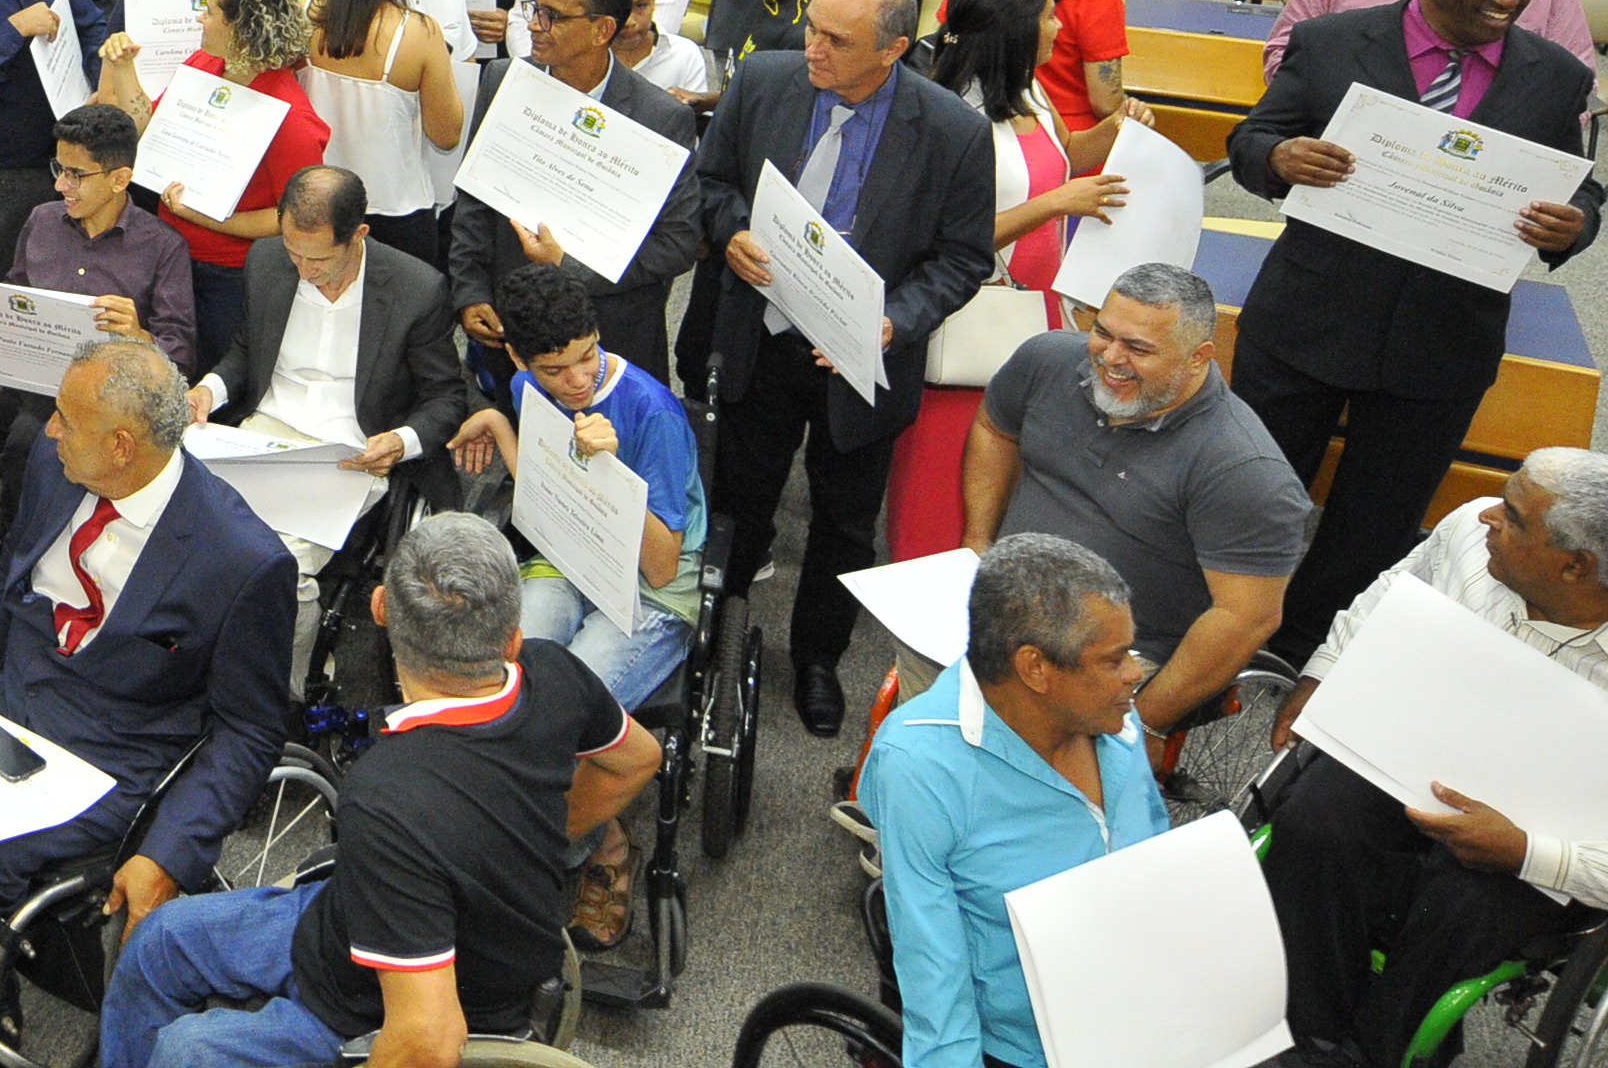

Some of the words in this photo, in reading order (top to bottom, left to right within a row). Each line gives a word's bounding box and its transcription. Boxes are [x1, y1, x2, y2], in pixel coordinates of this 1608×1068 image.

[523, 106, 557, 132] Diploma
[558, 126, 568, 137] de
[570, 133, 596, 153] Honra
[1370, 132, 1417, 156] Diploma
[1488, 174, 1529, 193] Mérito
[1426, 193, 1439, 204] da
[1441, 199, 1465, 212] Silva
